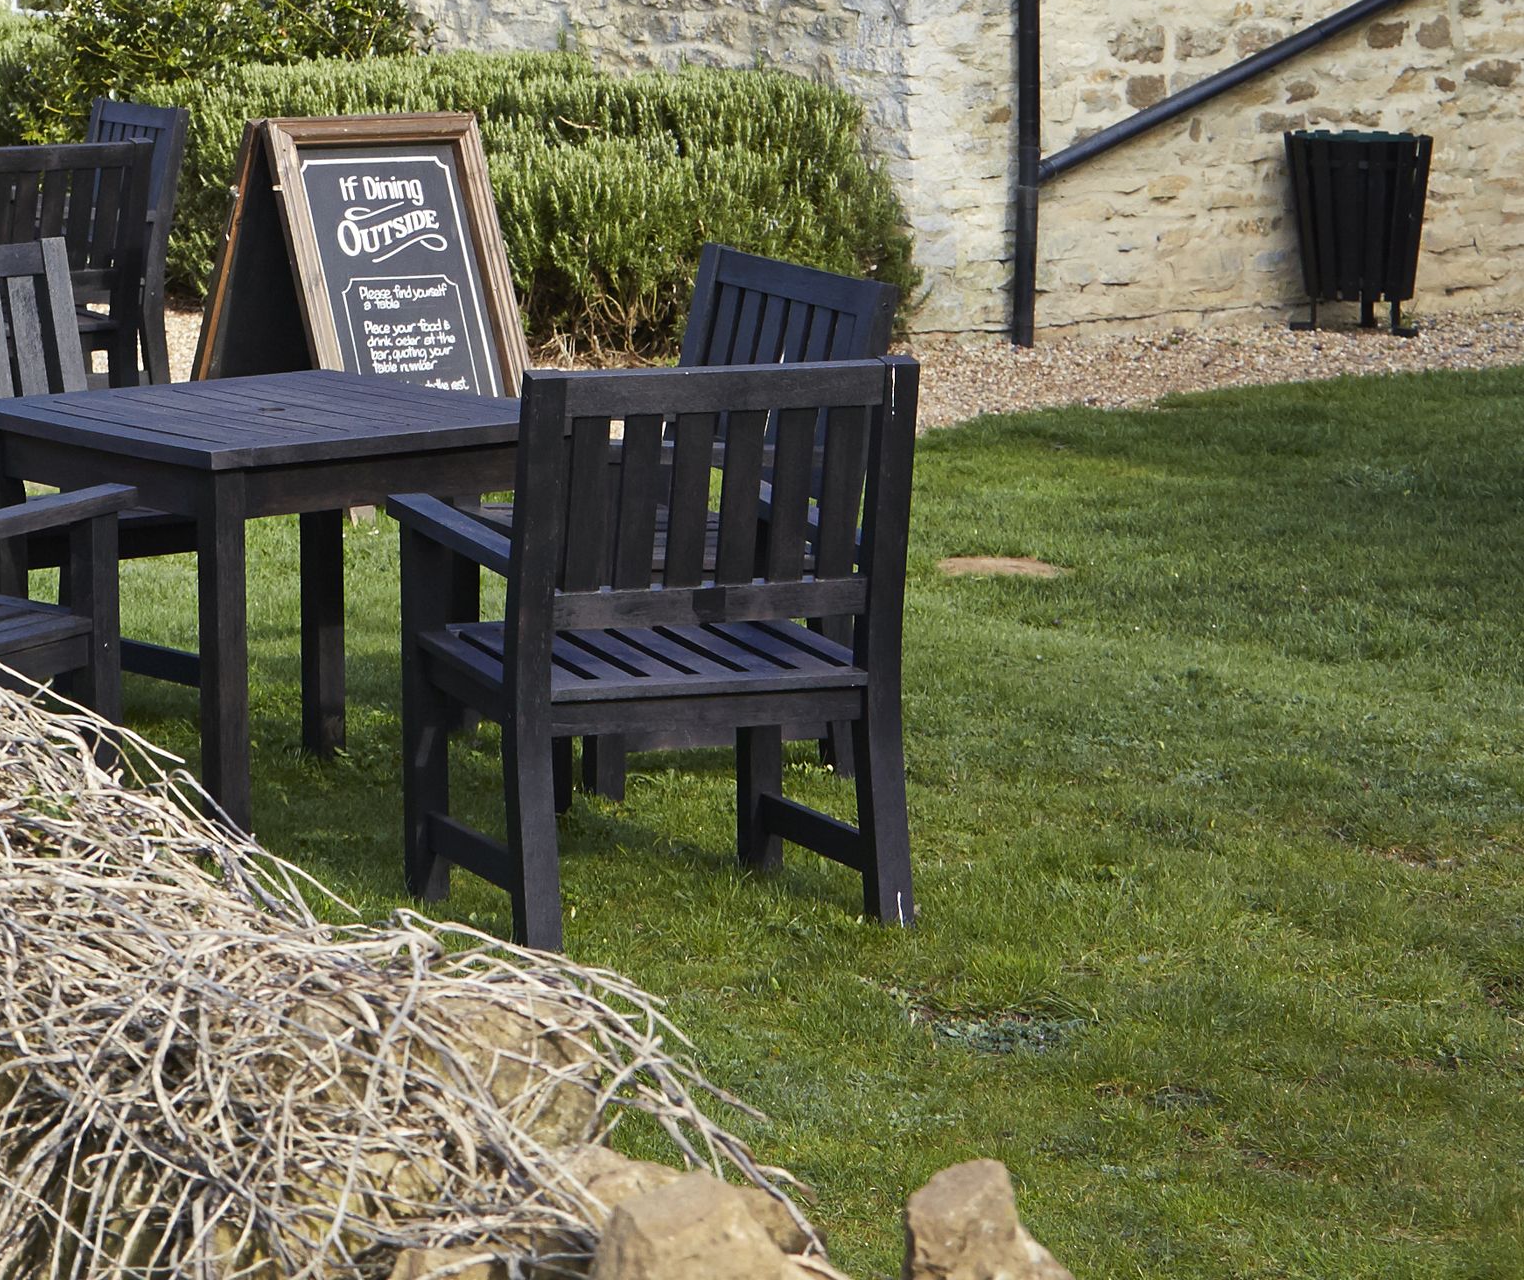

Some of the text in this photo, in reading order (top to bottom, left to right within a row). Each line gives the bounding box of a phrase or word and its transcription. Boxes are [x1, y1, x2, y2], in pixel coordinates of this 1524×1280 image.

[338, 175, 425, 207] If Dining
[336, 209, 440, 257] OUTSIDE
[358, 282, 448, 302] Please find yourself
[363, 298, 401, 311] a table
[363, 320, 391, 335] Place
[391, 322, 417, 337] your
[416, 317, 443, 333] food
[366, 335, 394, 348] drink
[436, 331, 456, 344] the
[392, 345, 428, 363] quoting
[428, 345, 454, 359] your
[371, 359, 398, 375] table
